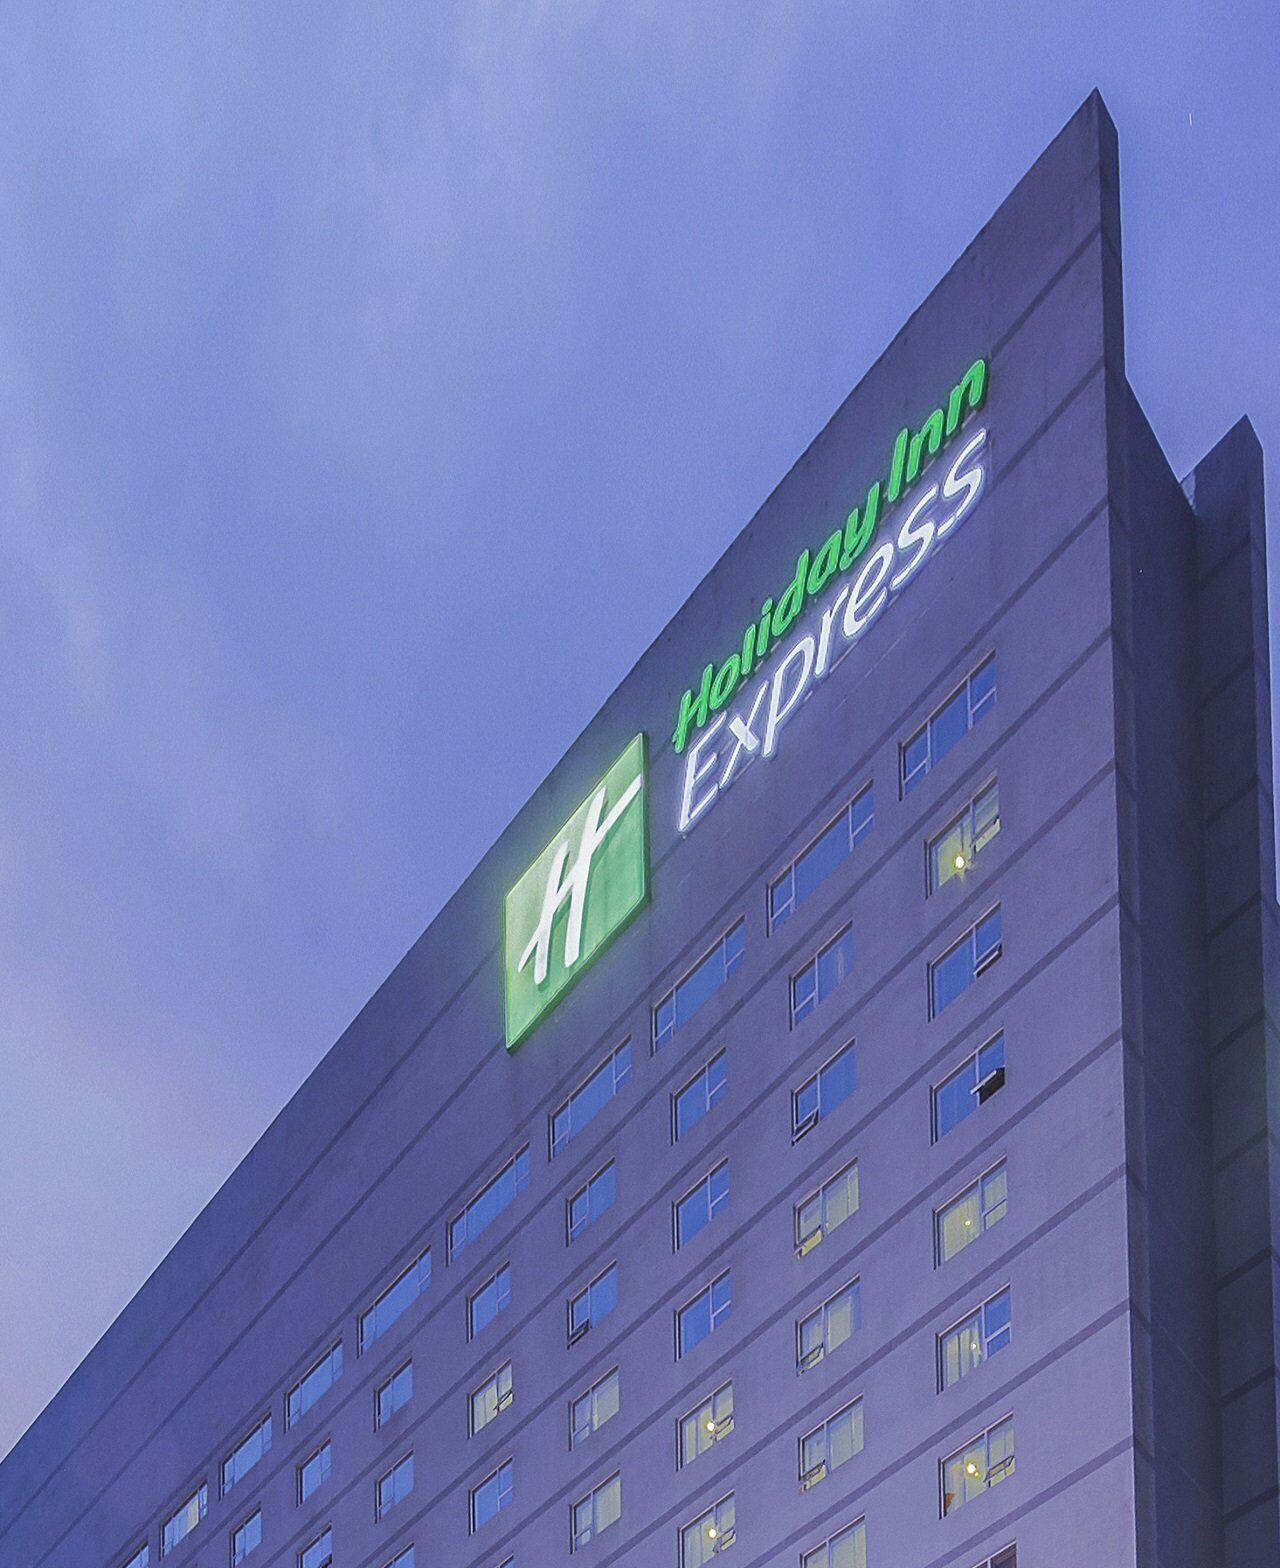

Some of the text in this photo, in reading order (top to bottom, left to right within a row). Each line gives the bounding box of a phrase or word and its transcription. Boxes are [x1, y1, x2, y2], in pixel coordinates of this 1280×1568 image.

[672, 357, 987, 755] Holiday Inn
[677, 426, 989, 833] Express
